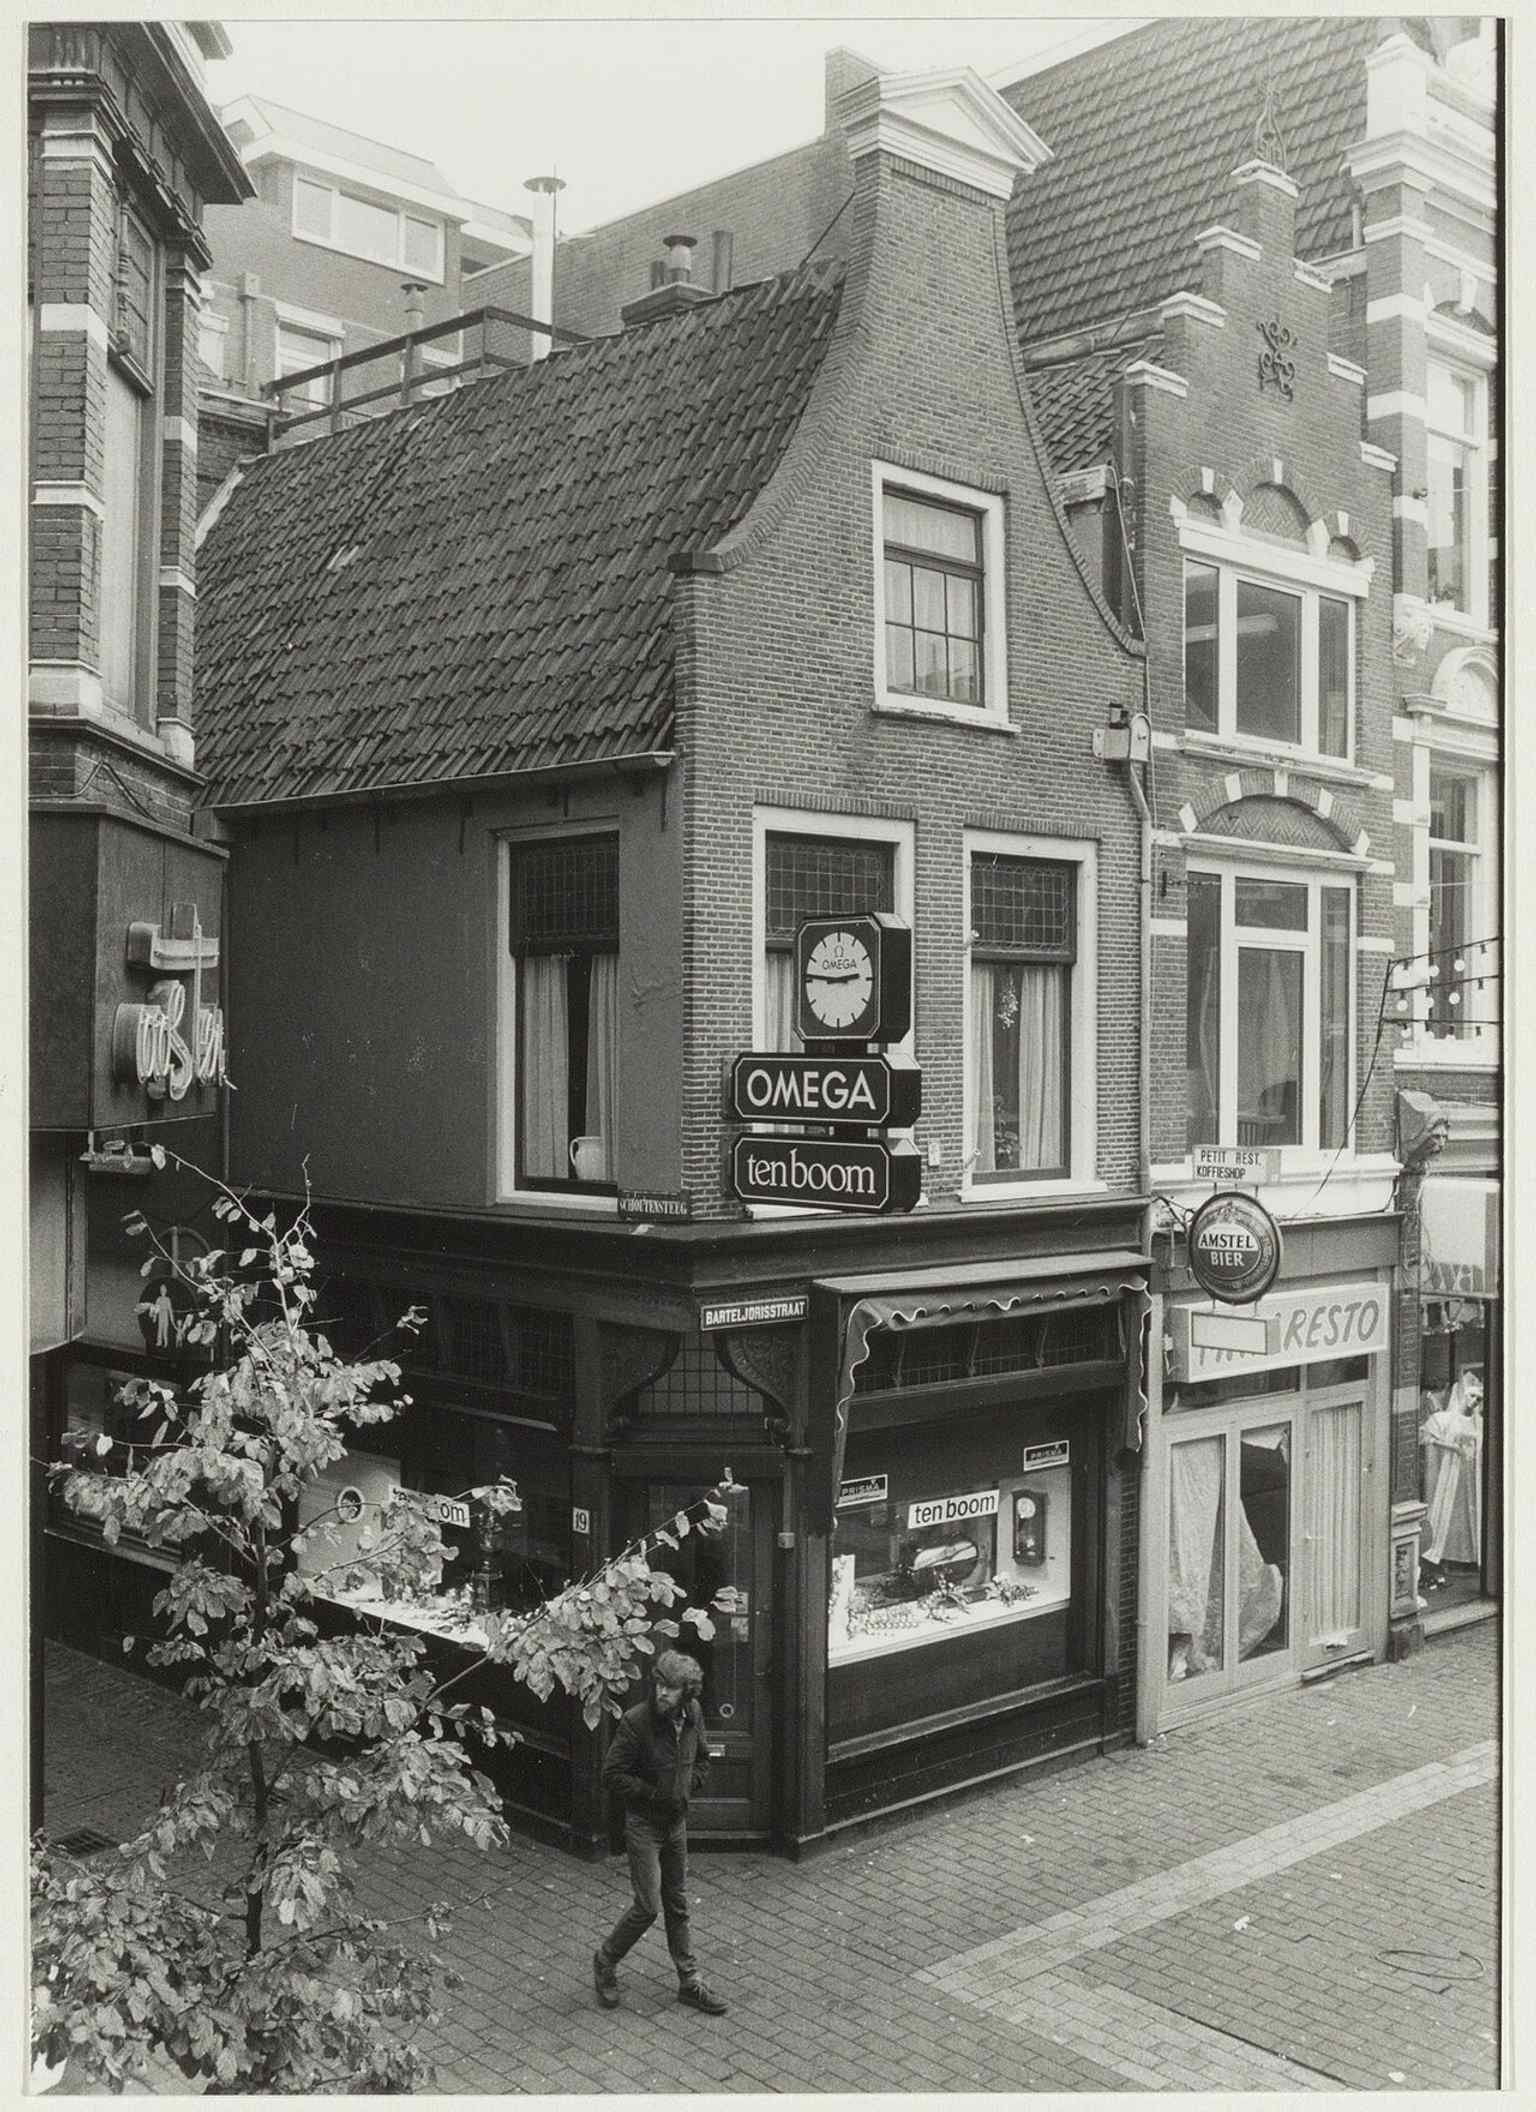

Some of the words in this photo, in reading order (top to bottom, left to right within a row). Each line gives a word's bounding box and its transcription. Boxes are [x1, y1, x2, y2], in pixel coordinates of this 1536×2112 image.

[822, 958, 857, 971] OMEGA
[746, 1069, 877, 1111] OMEGA
[1201, 1150, 1226, 1163] PETIT
[746, 1153, 787, 1189] ten
[1198, 1233, 1255, 1249] AMSTEL
[1209, 1251, 1246, 1268] BIER
[706, 1303, 805, 1325] BARTELJORISSTRAAT
[1283, 1299, 1381, 1352] RESTO
[915, 1503, 943, 1524] ten
[946, 1494, 995, 1519] boom
[575, 1511, 588, 1531] 19
